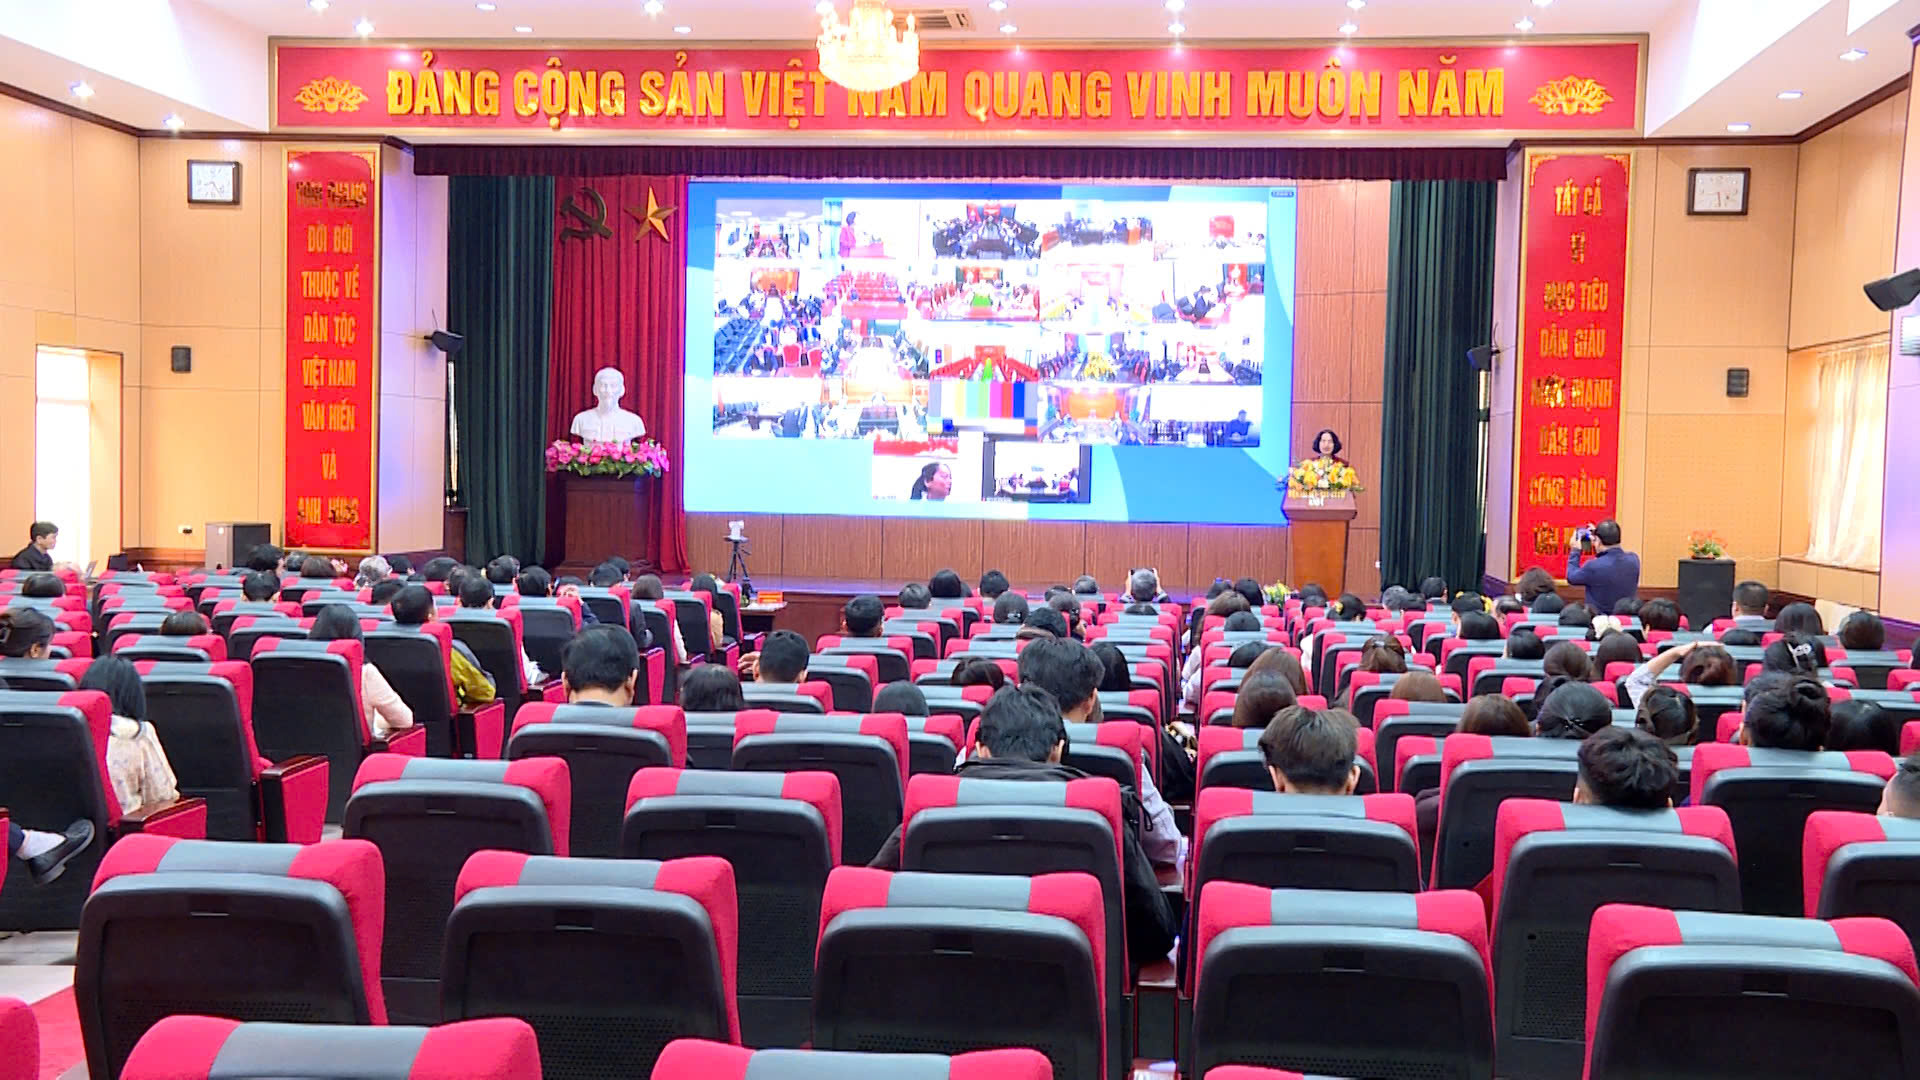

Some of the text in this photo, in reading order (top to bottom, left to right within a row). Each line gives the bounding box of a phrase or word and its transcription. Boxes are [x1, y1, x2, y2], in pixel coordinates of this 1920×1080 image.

[387, 50, 501, 117] ĐẢNG
[513, 57, 625, 130] CỘNG
[640, 50, 725, 117] SẢN
[742, 58, 831, 130] VIỆT
[964, 71, 1111, 122] QUANG
[1127, 70, 1231, 119] VINH
[1246, 58, 1381, 119] MUÔN
[1398, 55, 1505, 118] NĂM
[1555, 177, 1579, 216] TẤT
[301, 265, 340, 302] THUỘC
[1579, 276, 1608, 312] TIÊU
[303, 311, 356, 348] DÂN TỘC
[302, 354, 356, 390] VIỆT NAM
